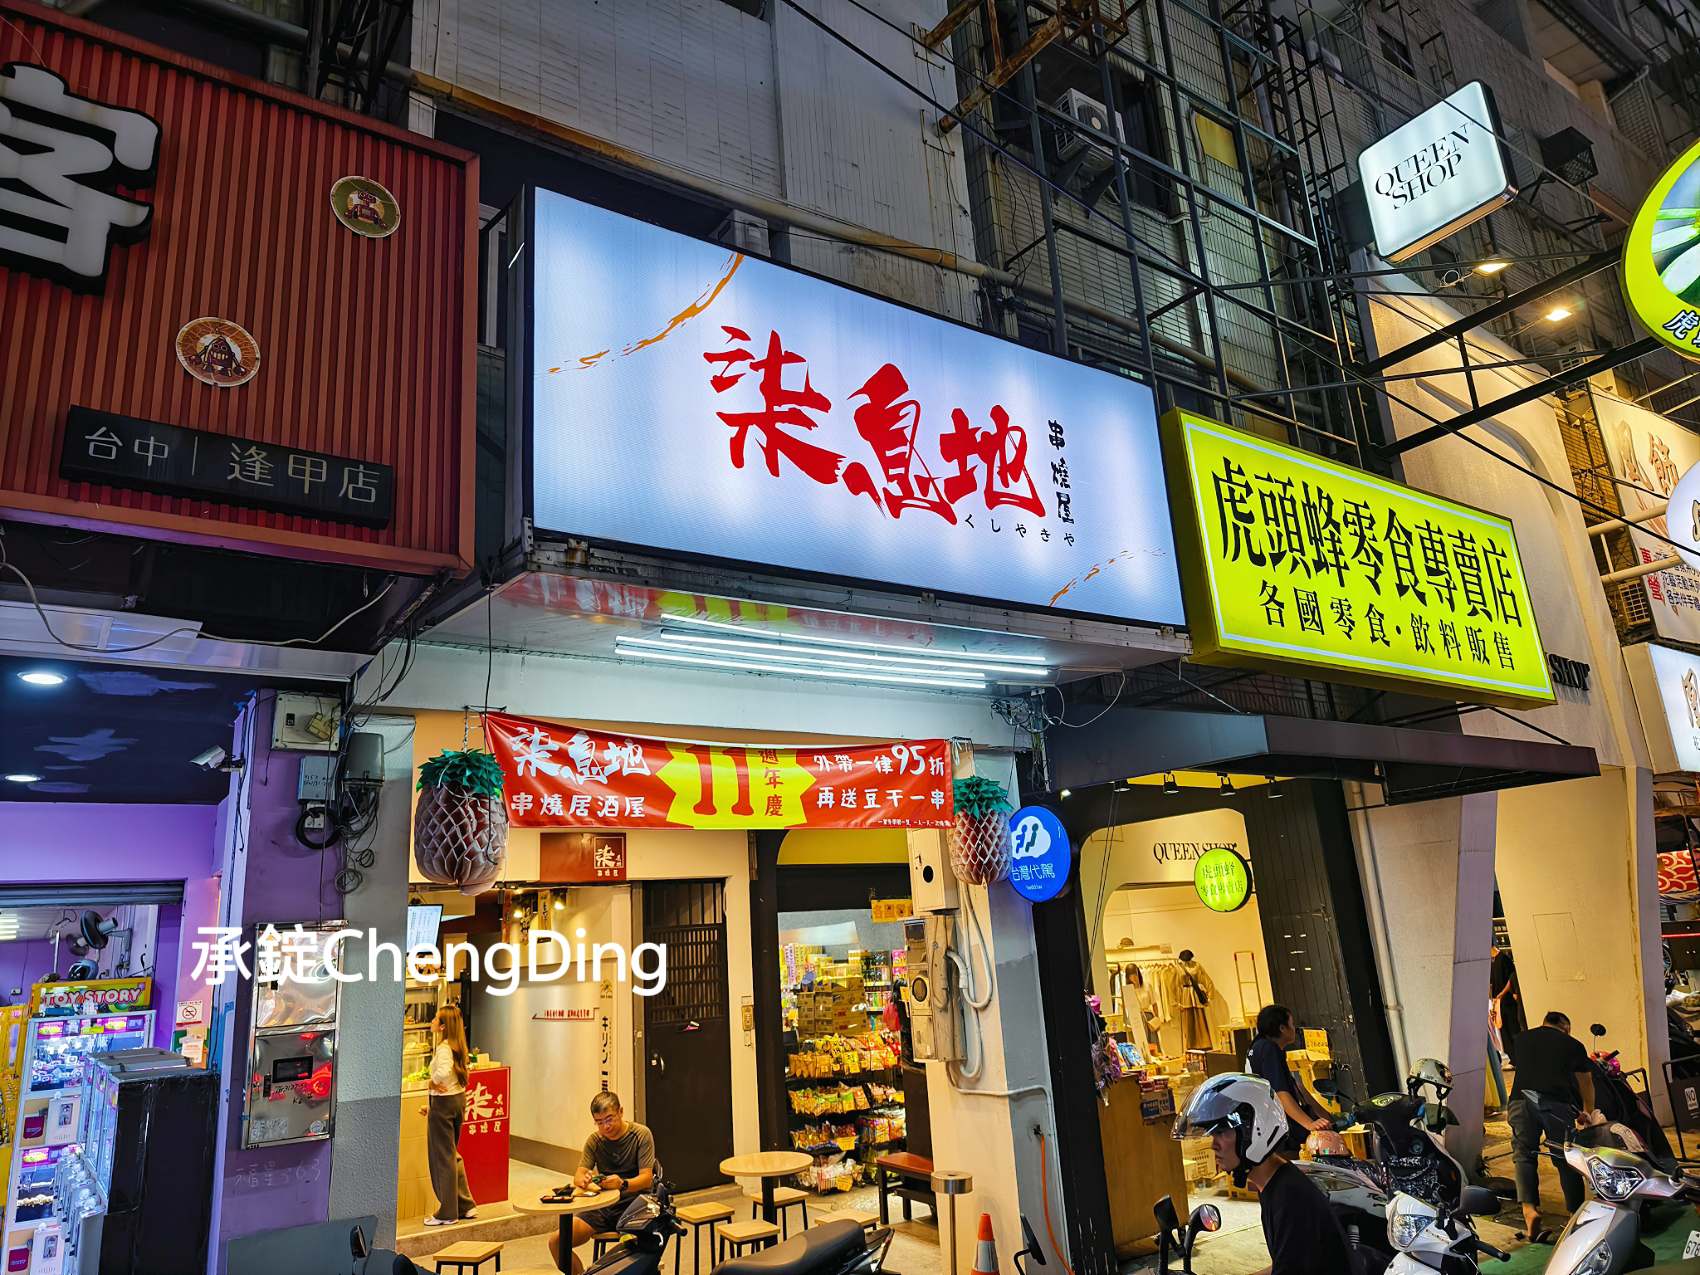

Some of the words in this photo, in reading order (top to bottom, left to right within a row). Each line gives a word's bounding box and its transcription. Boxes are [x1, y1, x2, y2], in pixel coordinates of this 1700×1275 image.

[1375, 122, 1469, 197] QUEEN
[1391, 153, 1462, 210] SHOP
[1662, 309, 1700, 348] 虎
[703, 325, 1046, 525] 柒息地
[84, 426, 170, 467] 台中
[227, 445, 382, 503] 逢甲店
[1047, 419, 1075, 525] 串燒屋
[964, 513, 1075, 547] くしやきや
[1212, 456, 1523, 629] 虎頭蜂零食專賣店
[510, 726, 652, 786] 柒息地
[758, 748, 785, 818] 週年慶
[510, 791, 646, 818] 串燒居酒屋
[816, 786, 946, 810] 再送豆干一串
[1153, 842, 1201, 865] QUEEN
[42, 991, 82, 1006] TOY
[84, 987, 142, 1005] STORY
